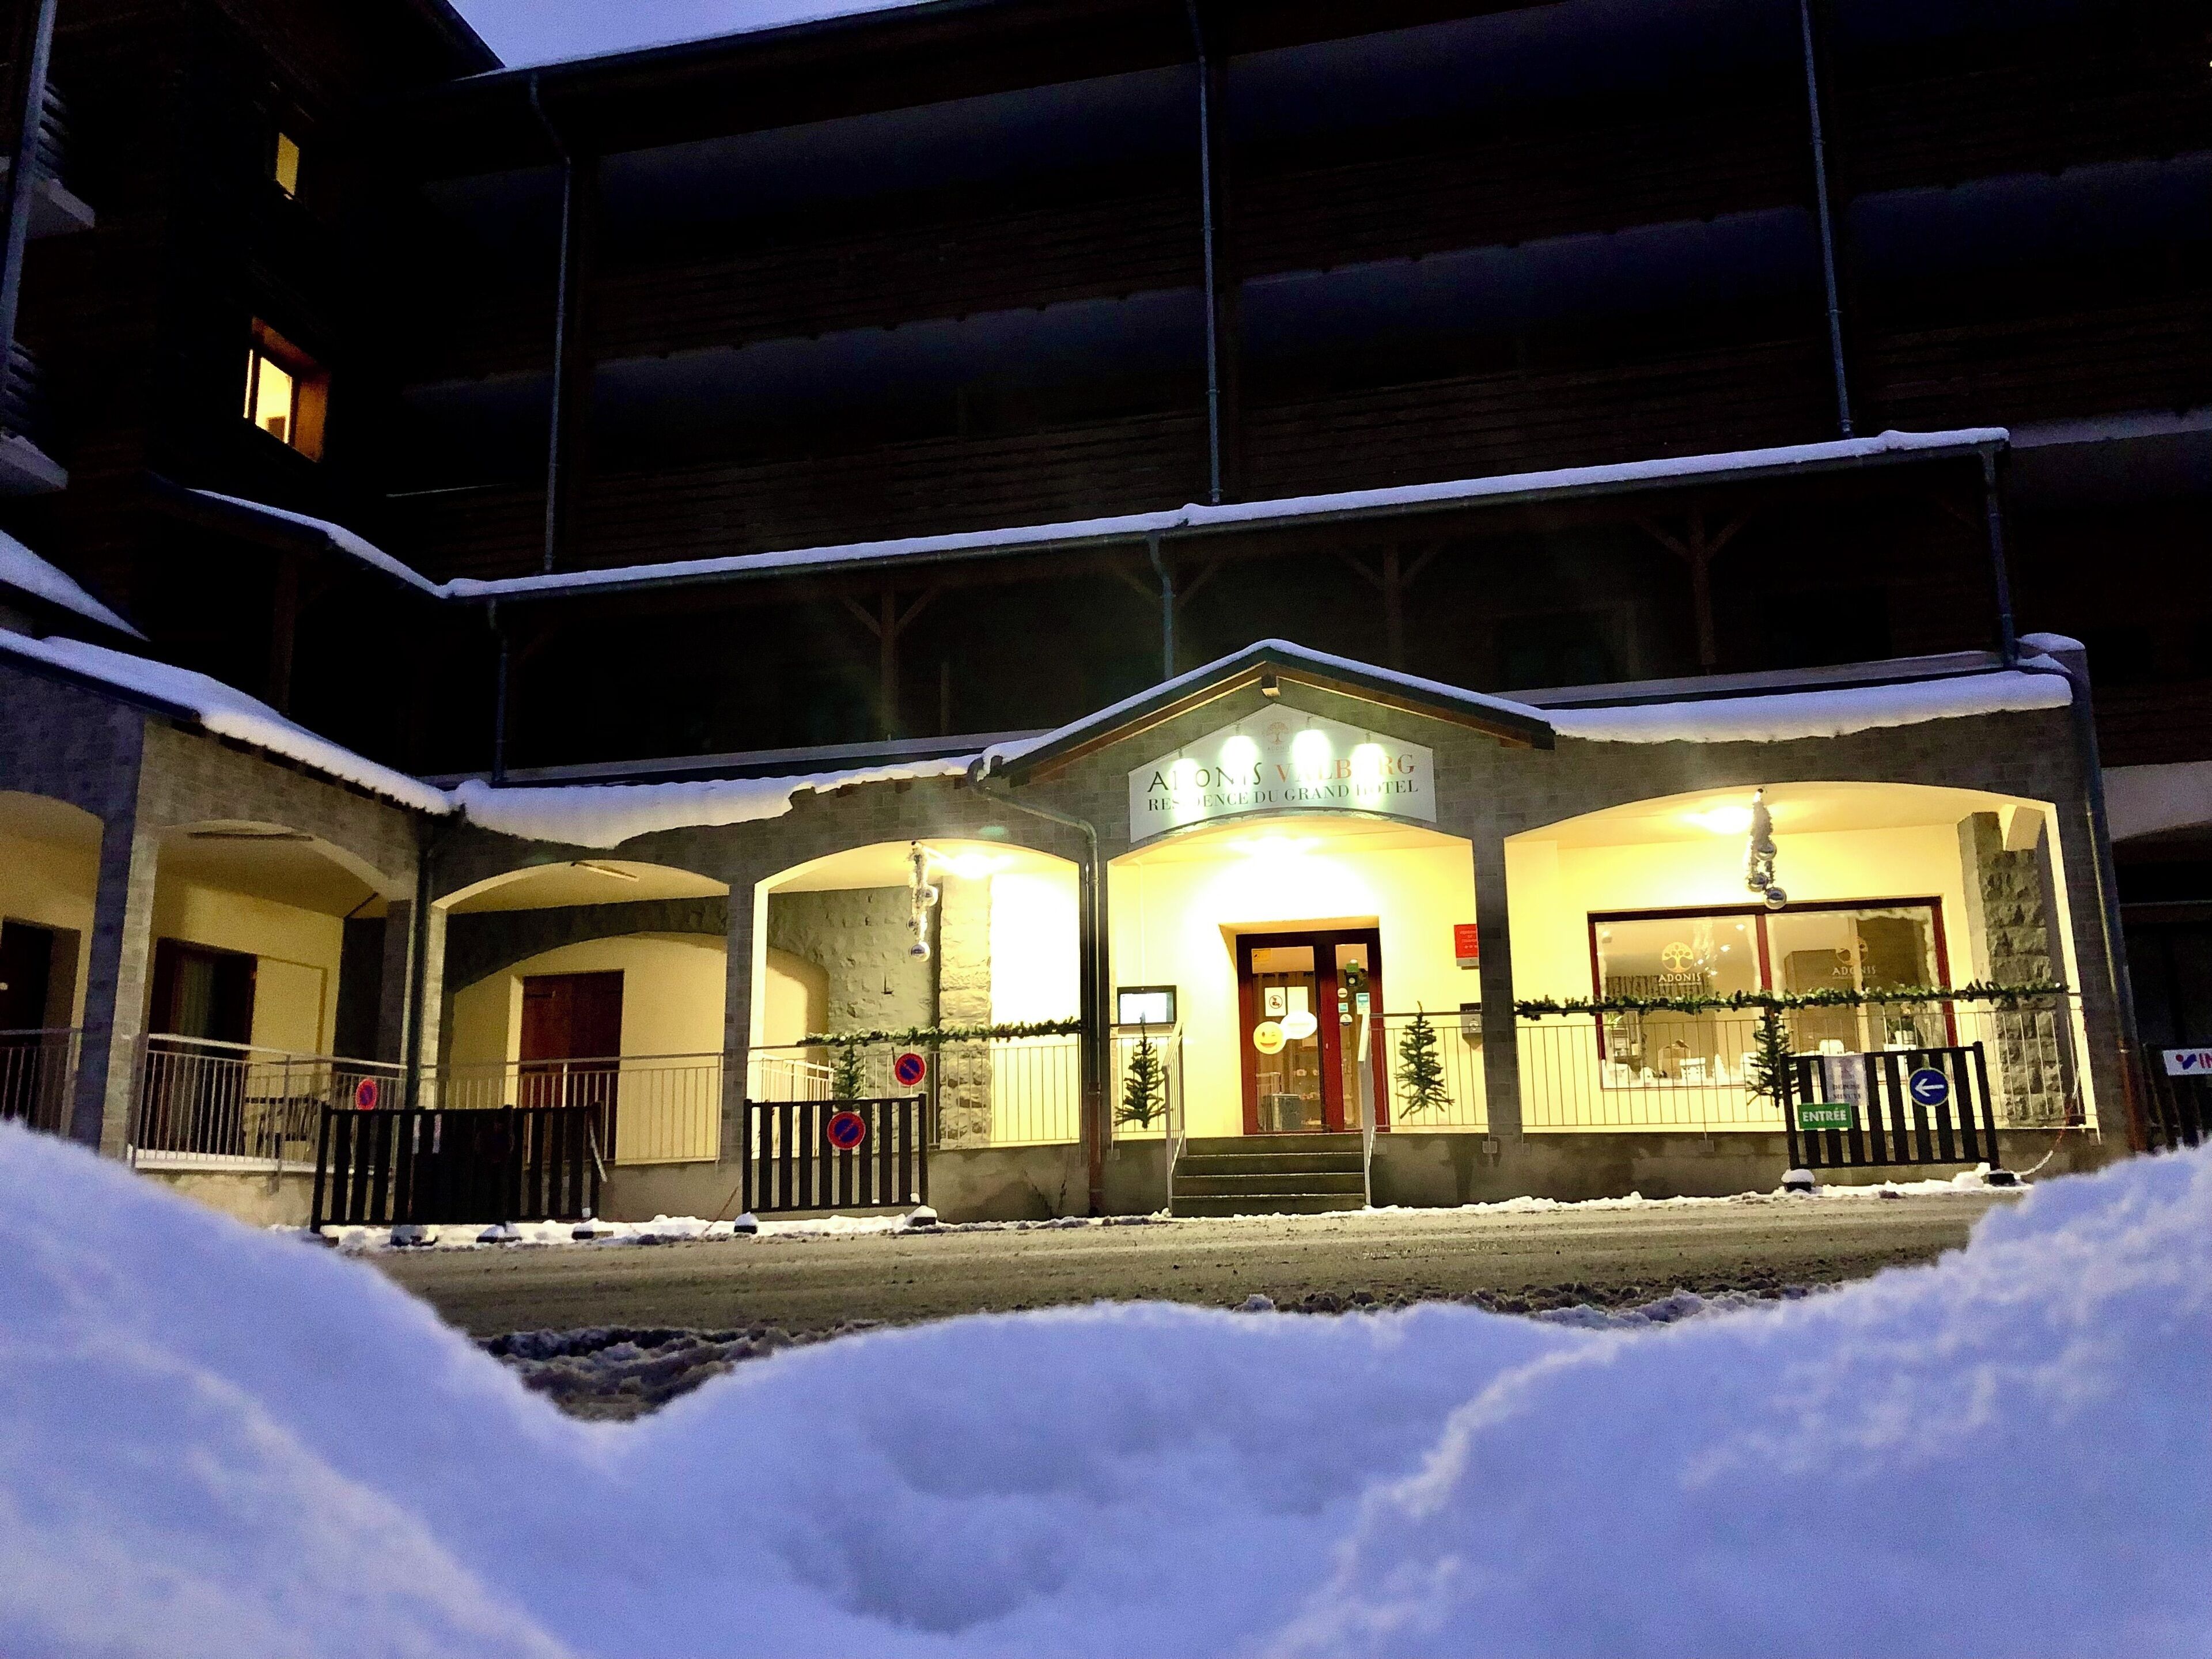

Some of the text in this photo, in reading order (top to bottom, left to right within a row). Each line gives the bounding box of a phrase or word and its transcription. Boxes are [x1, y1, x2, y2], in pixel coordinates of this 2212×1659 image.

[1253, 789, 1279, 804] DU
[1284, 784, 1349, 802] GRAND
[1658, 972, 1701, 982] ADONIS
[1802, 1107, 1847, 1122] ENTRÉE
